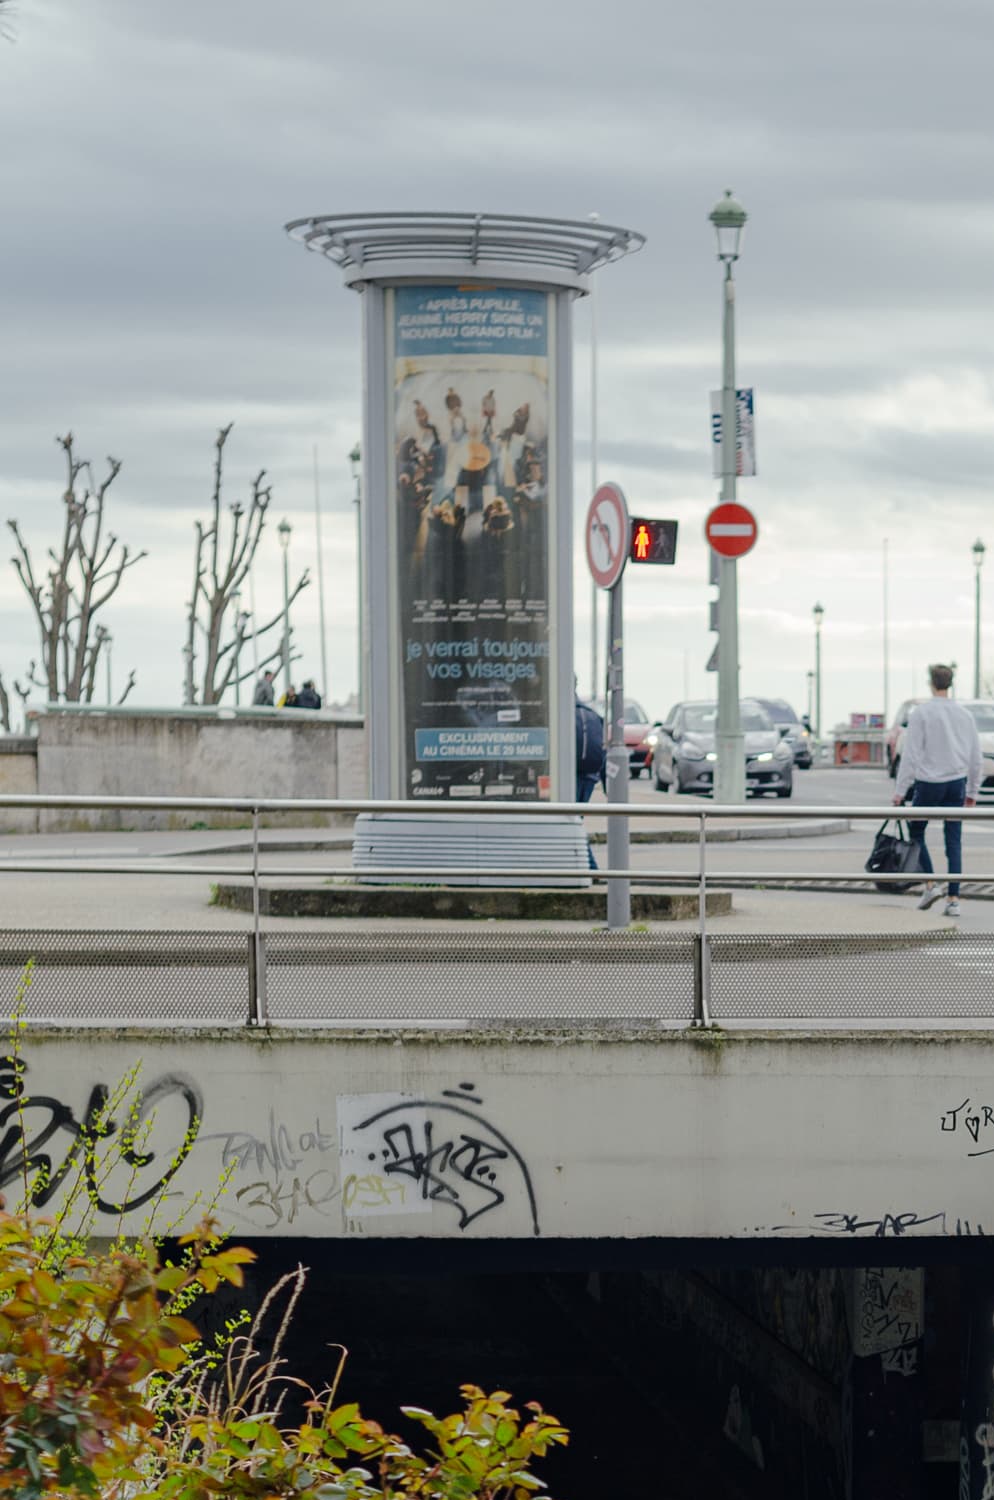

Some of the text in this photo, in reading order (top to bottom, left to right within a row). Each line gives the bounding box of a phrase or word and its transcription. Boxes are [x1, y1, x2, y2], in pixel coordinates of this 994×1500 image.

[401, 327, 458, 339] NOUVEAU
[460, 326, 505, 338] GRAND
[406, 638, 422, 662] je
[426, 637, 478, 657] verrai
[427, 659, 537, 682] vos visages
[439, 732, 528, 744] EXCLUSIVEMENT
[422, 746, 438, 757] AU
[487, 745, 501, 756] LE
[516, 745, 545, 756] MARS
